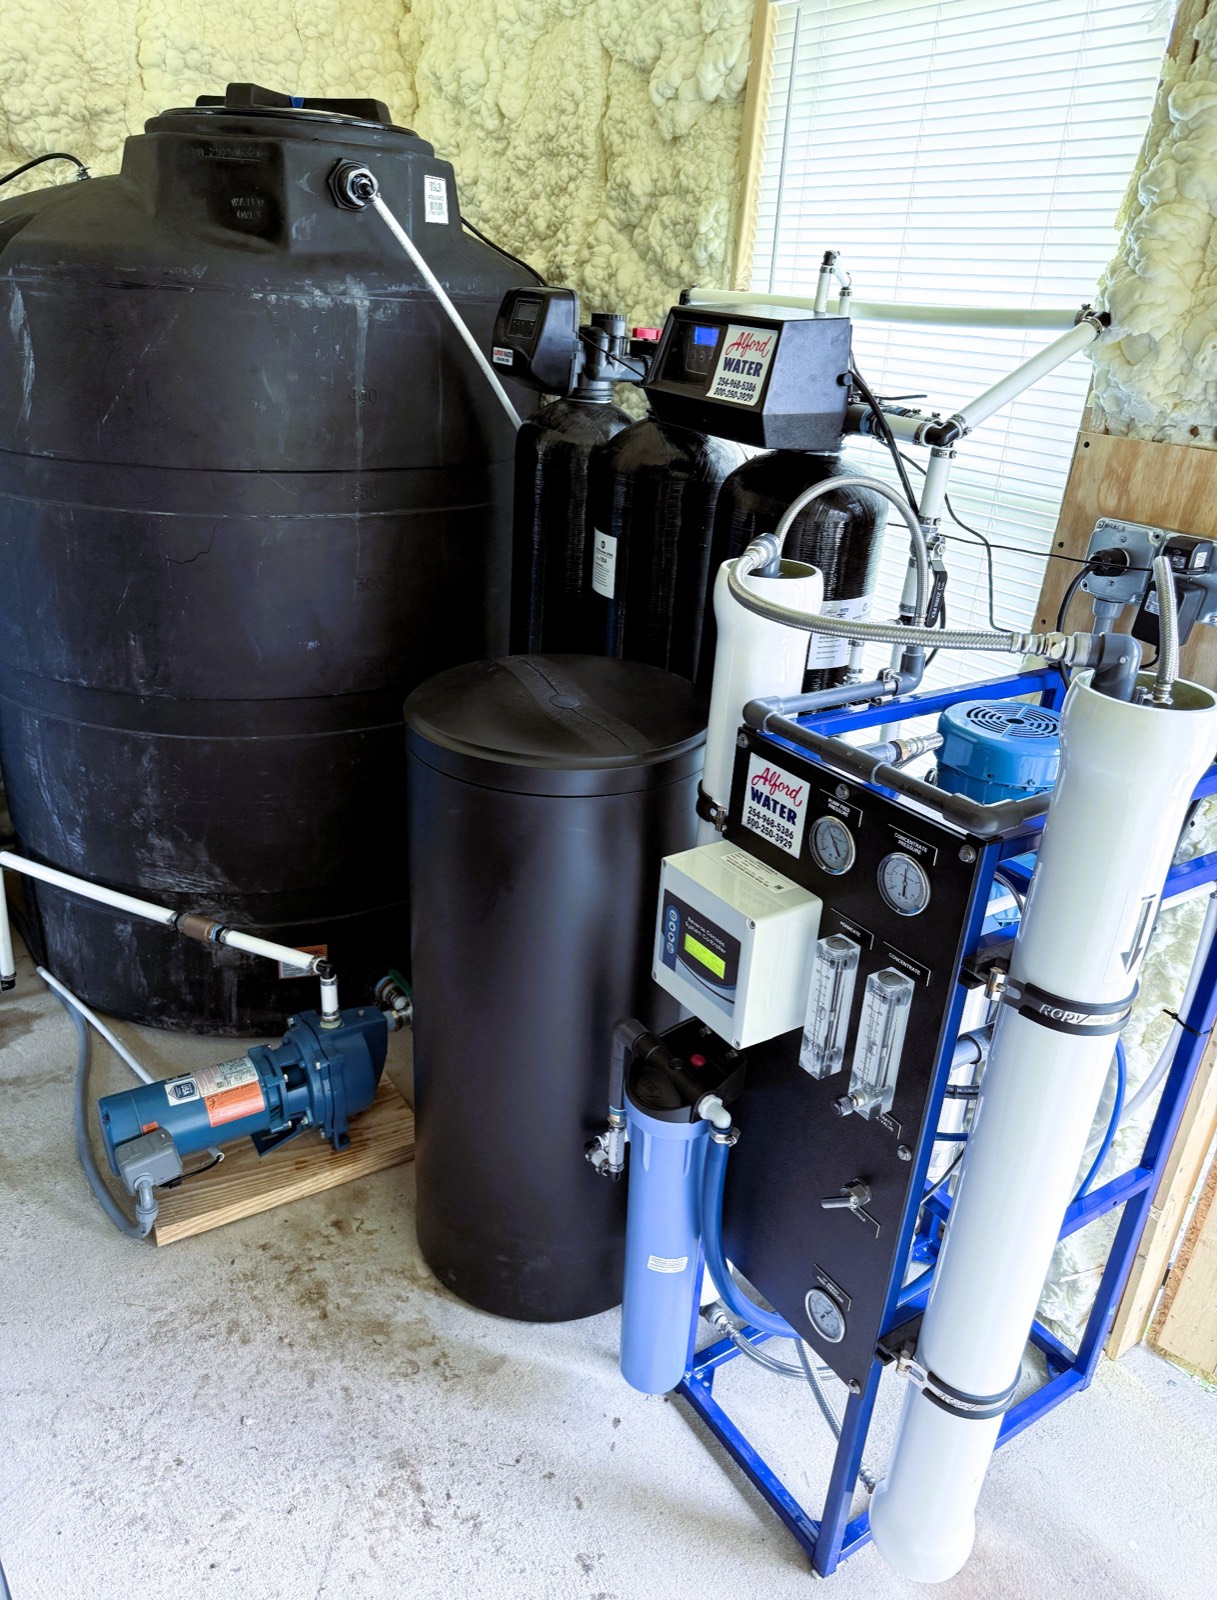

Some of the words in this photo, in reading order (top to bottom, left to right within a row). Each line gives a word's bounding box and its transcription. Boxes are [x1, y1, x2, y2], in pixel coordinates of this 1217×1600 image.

[724, 331, 773, 358] Alford
[722, 356, 764, 378] WATER
[713, 387, 754, 402] 800-250-3929
[717, 376, 757, 392] 254-968-5386
[750, 767, 803, 807] Alford
[750, 786, 798, 826] WATER
[746, 815, 793, 850] 800-250-3929
[747, 806, 794, 840] 254-968-5386
[893, 832, 928, 853] CONCENTRATE
[888, 952, 921, 976] CONCENTRATE
